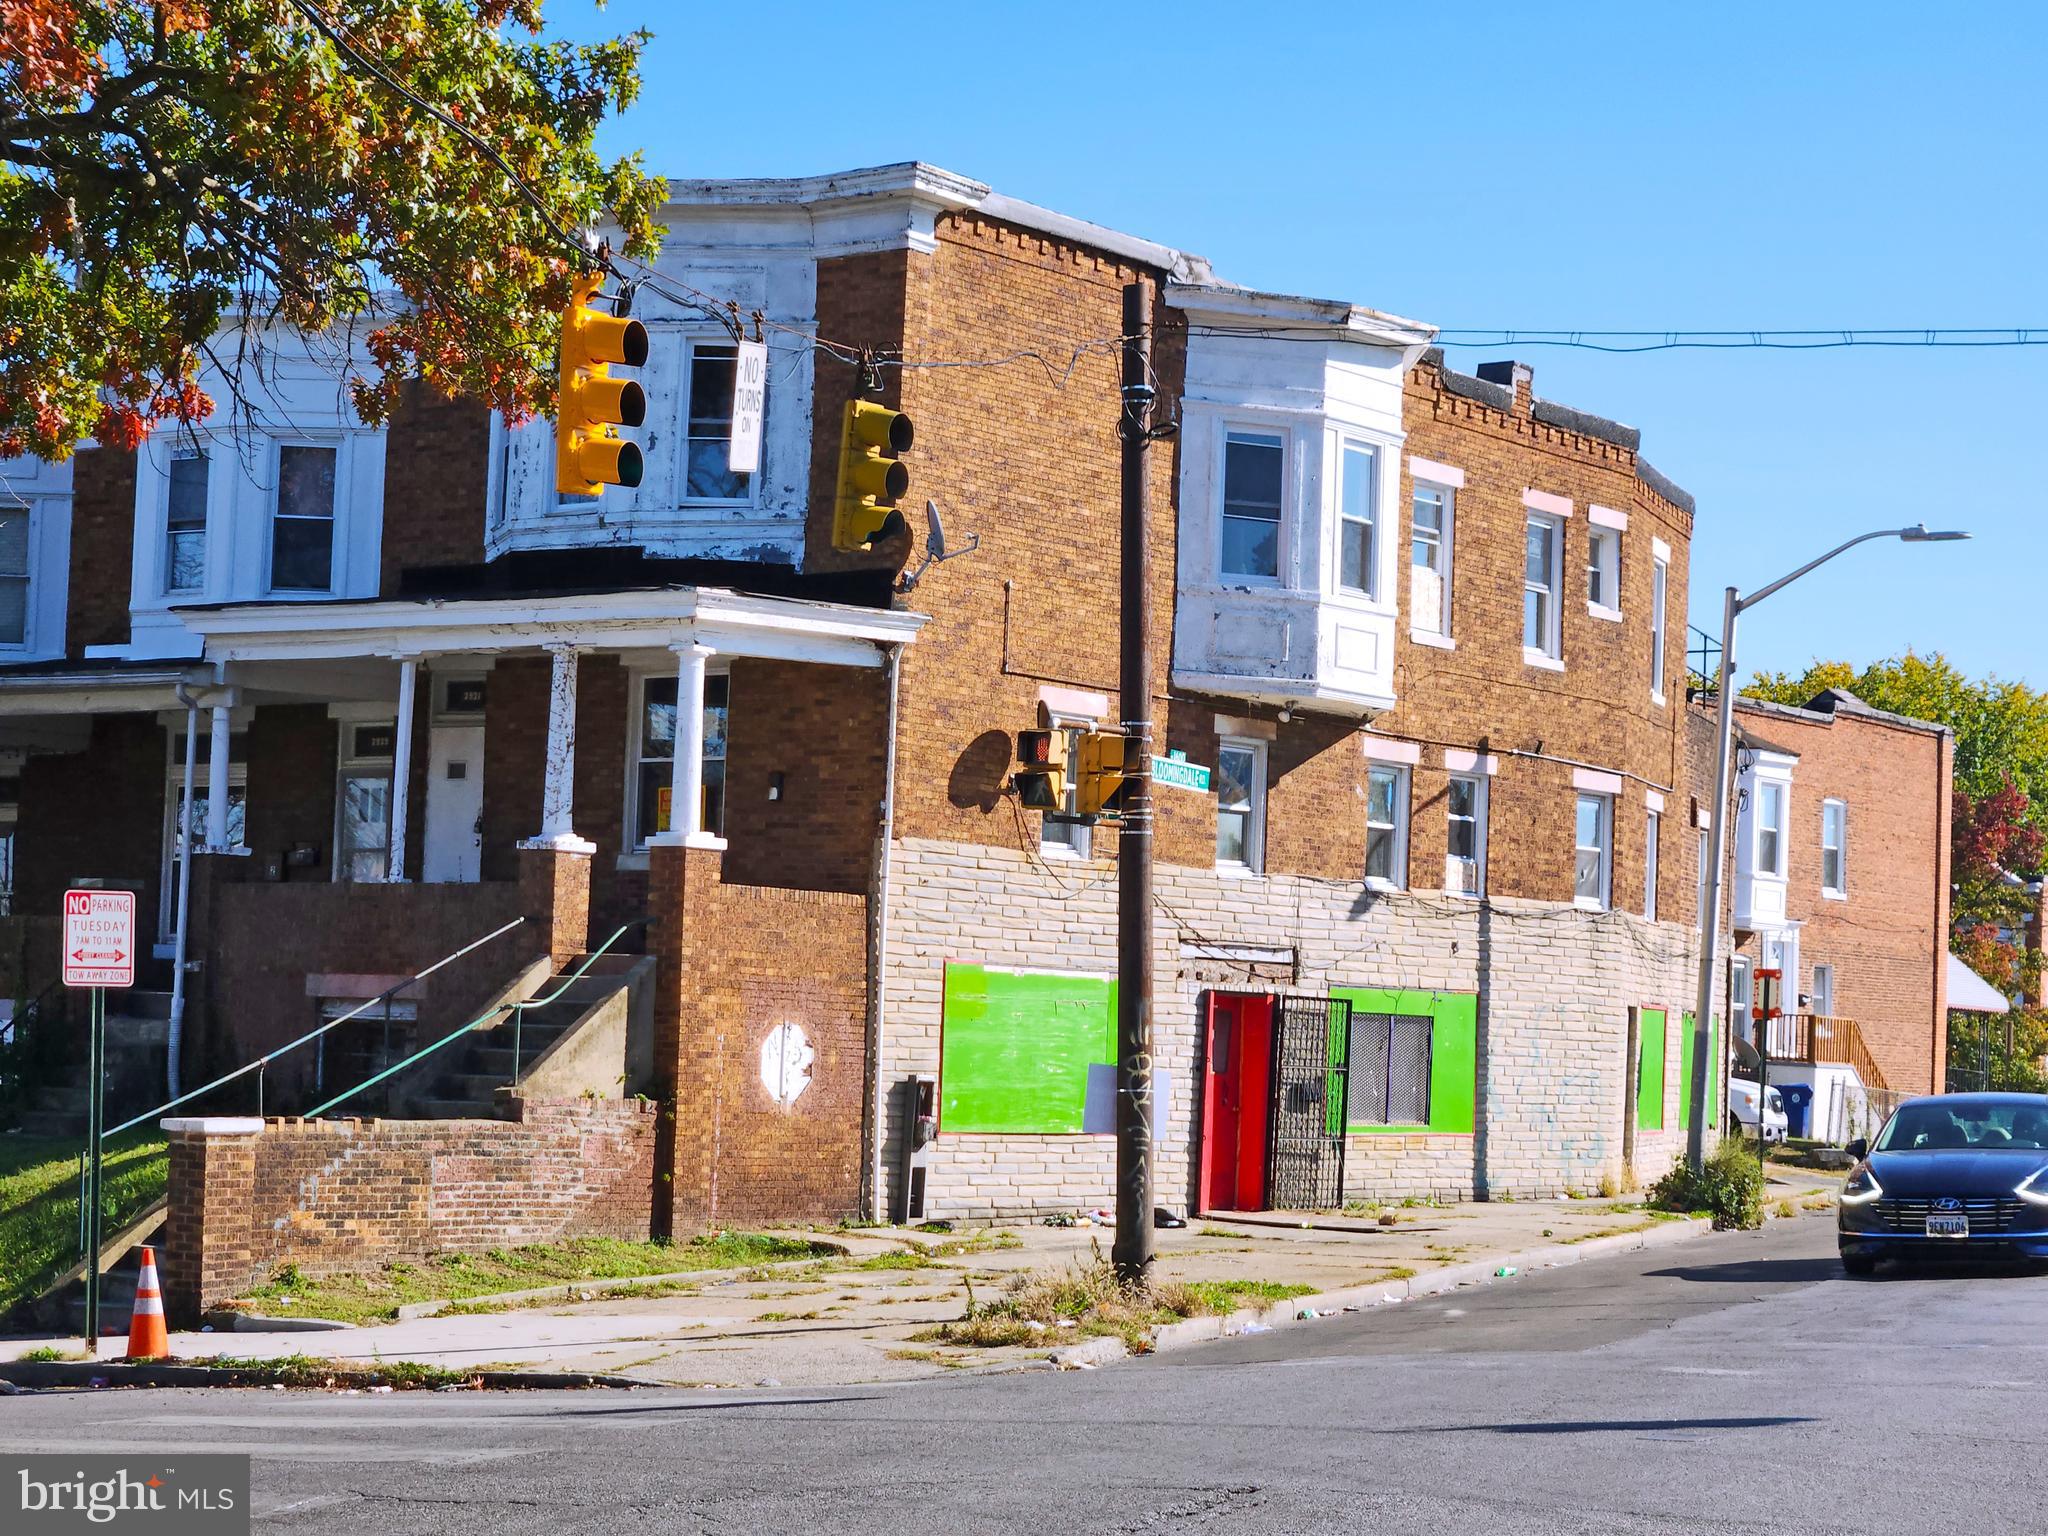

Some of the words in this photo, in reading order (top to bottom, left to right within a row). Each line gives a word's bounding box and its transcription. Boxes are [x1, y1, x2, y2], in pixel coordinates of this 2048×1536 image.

[743, 356, 759, 384] NO
[738, 388, 762, 413] TURNS
[741, 417, 751, 433] ON
[1152, 759, 1200, 787] BLOOMINGDALE
[68, 896, 89, 915] NO
[92, 899, 129, 913] PARKING
[73, 920, 127, 932] TUESDAY
[75, 936, 90, 945] 7AM
[93, 936, 102, 945] TO
[105, 937, 122, 946] 11AM
[69, 970, 84, 979] TOW
[86, 971, 107, 980] AWAY
[110, 971, 129, 981] ZONE
